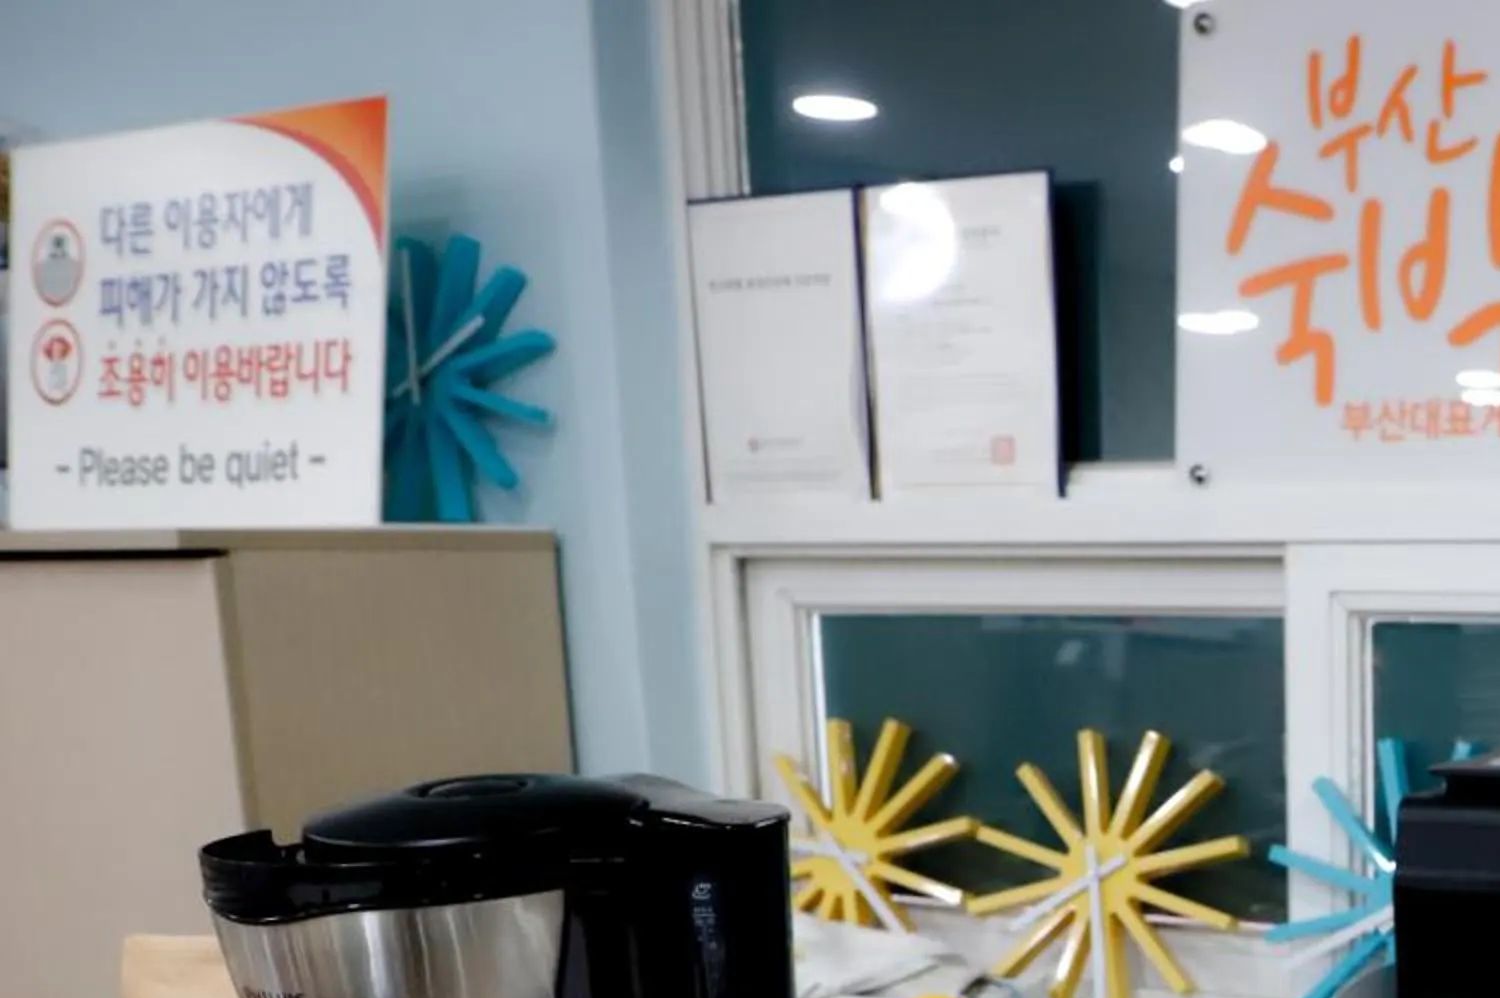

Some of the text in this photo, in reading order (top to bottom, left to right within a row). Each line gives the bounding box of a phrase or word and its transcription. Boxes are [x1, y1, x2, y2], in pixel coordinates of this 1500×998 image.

[1307, 33, 1489, 193] 부산
[100, 181, 314, 256] 다른 이용자에게
[99, 253, 352, 328] 피해가 가지 않도록
[98, 338, 353, 408] 조용히 이용바랍니다
[78, 446, 170, 487] Please
[177, 444, 216, 485] be
[225, 439, 299, 489] quiet
